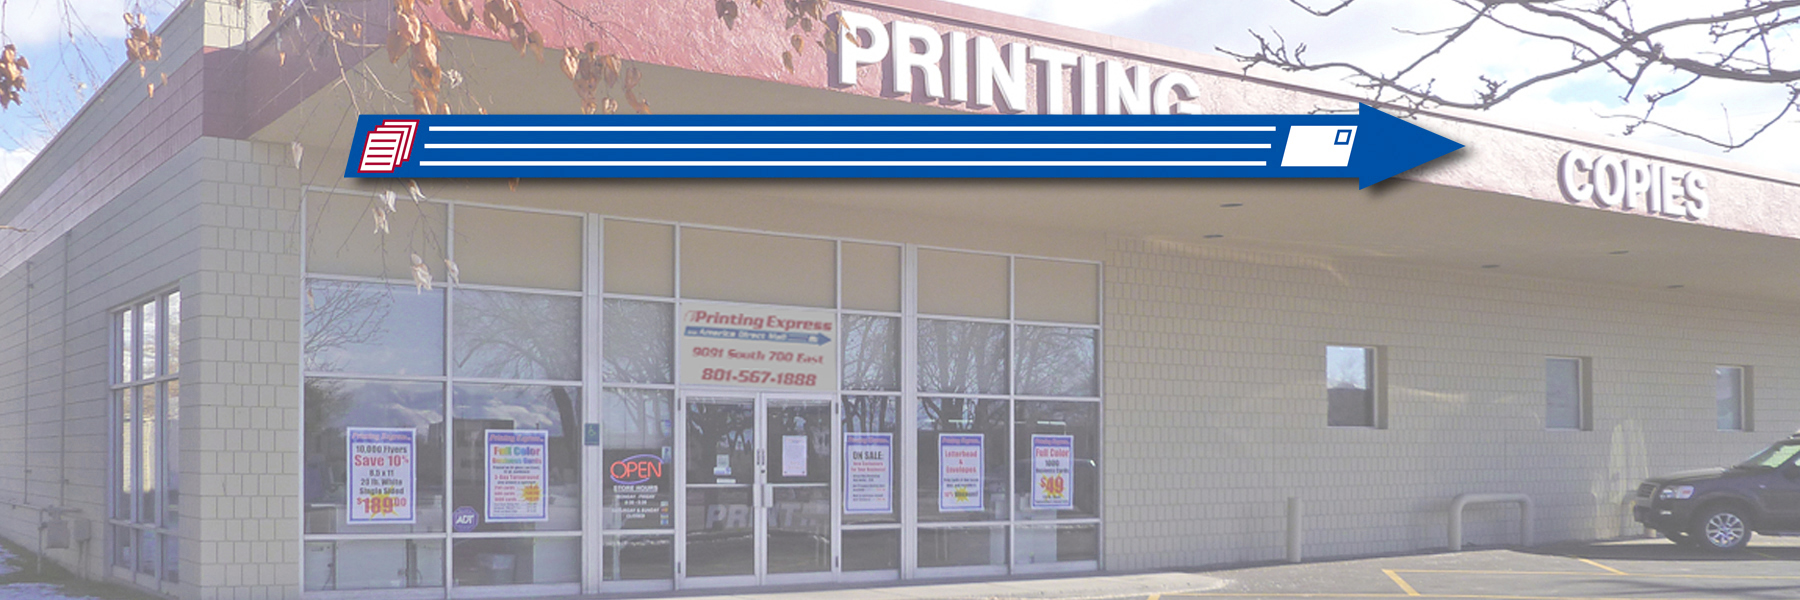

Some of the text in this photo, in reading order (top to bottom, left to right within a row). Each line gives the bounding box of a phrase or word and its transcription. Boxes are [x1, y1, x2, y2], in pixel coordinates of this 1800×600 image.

[829, 9, 1200, 115] PRINTING
[1557, 149, 1709, 220] COPIES
[695, 310, 833, 331] Printing Express
[692, 346, 824, 365] 9091 South 700 East
[383, 445, 407, 454] Flyers
[493, 446, 541, 456] Full Color
[853, 451, 863, 460] ON
[944, 450, 977, 458] Letterhead
[1036, 448, 1070, 458] Full Color
[354, 454, 385, 467] Save
[610, 461, 662, 479] OPEN
[1040, 475, 1064, 494] $49
[455, 515, 474, 524] ADT
